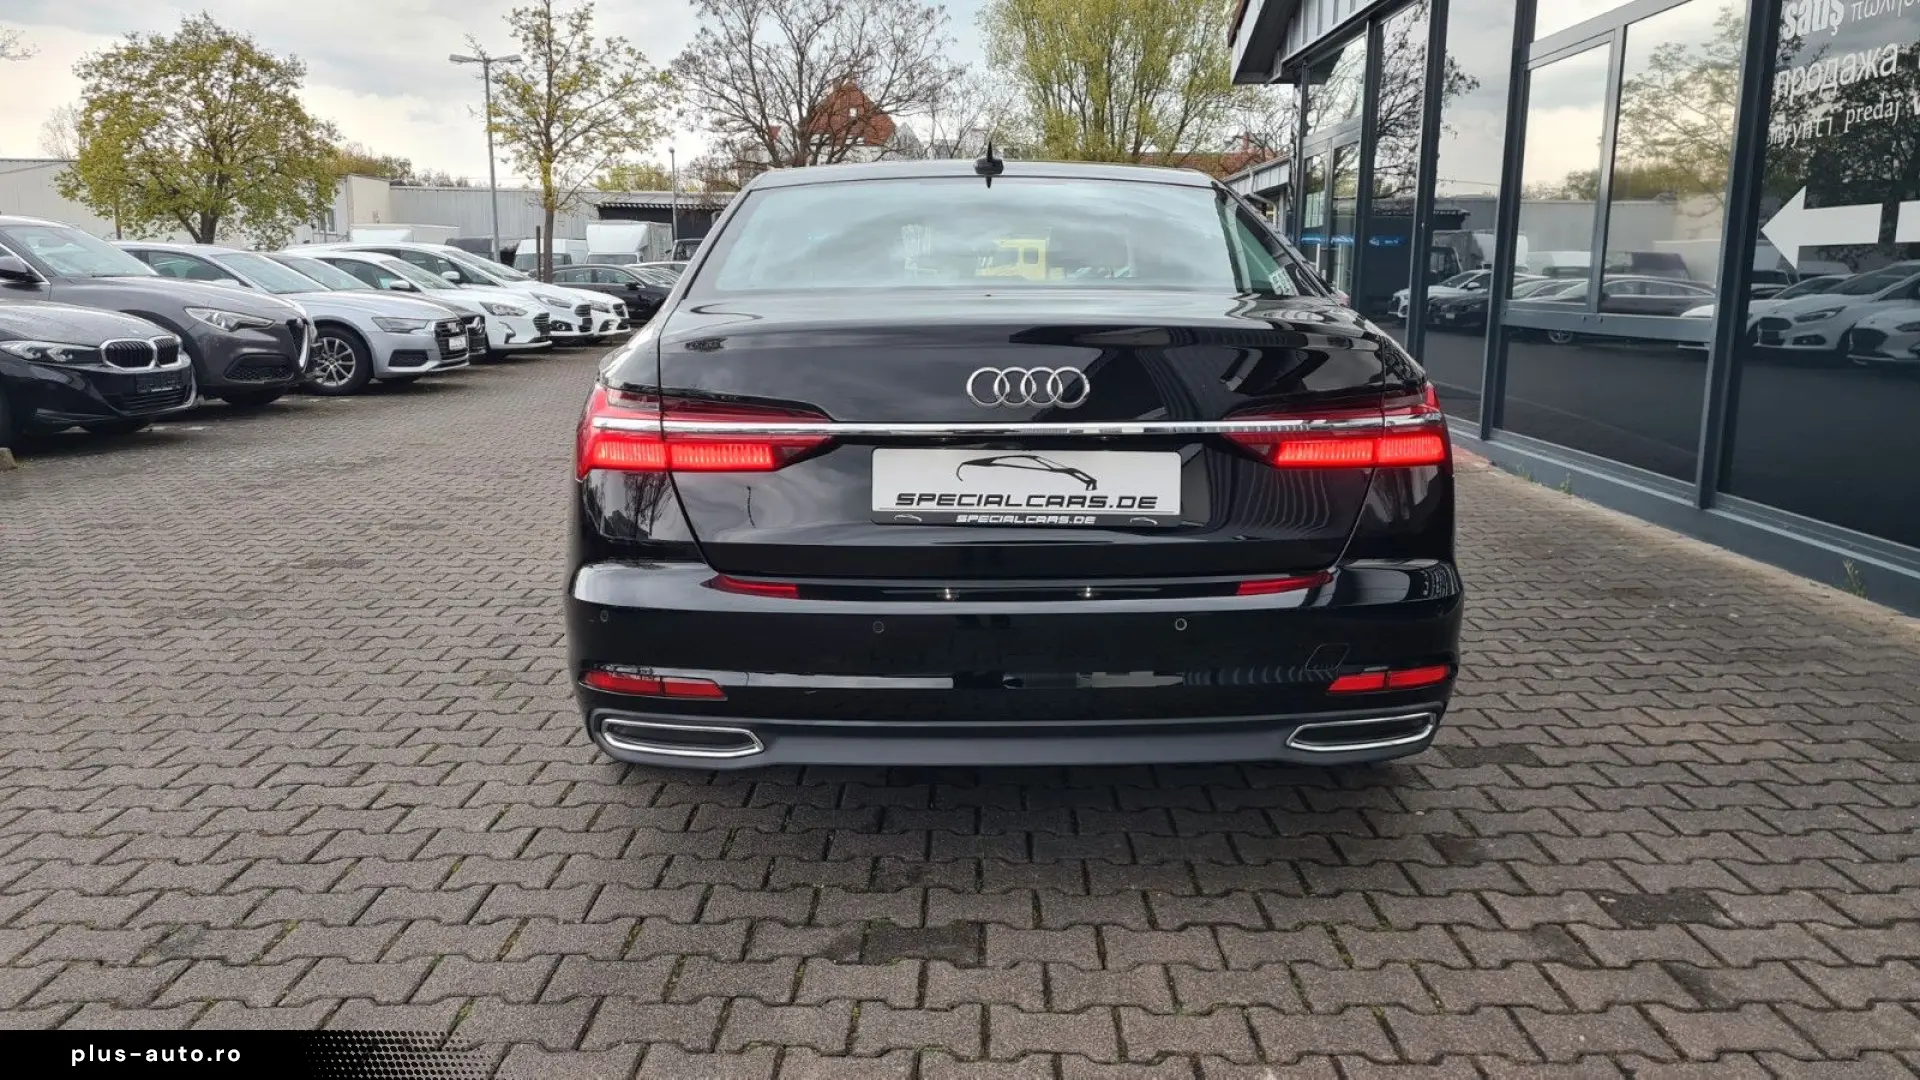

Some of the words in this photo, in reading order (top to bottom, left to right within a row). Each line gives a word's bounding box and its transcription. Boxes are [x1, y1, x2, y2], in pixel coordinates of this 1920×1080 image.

[1774, 43, 1898, 106] продажа
[1843, 90, 1900, 133] predaj
[895, 492, 1158, 509] SPECIALCARS.DE
[955, 514, 1097, 525] SPECIALCARS.DE
